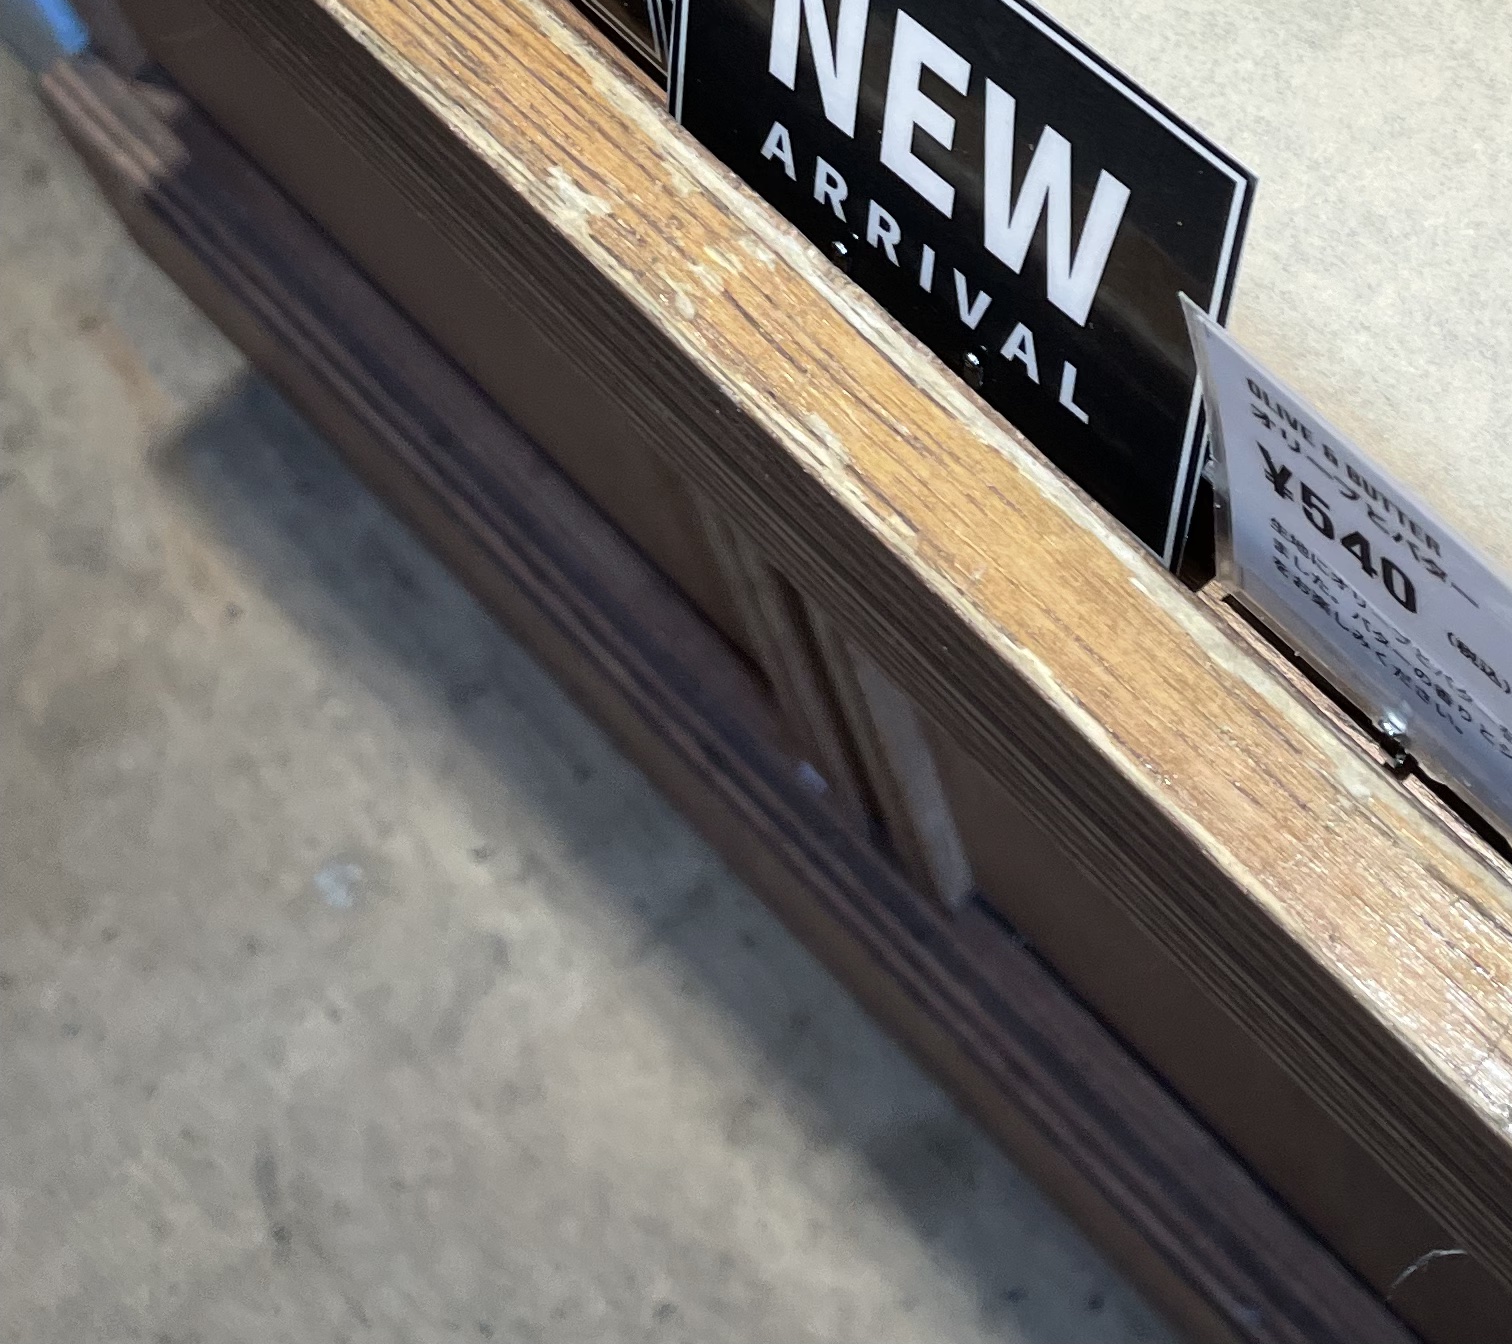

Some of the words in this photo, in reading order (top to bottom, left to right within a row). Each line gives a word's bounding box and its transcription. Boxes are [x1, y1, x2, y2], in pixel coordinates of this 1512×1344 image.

[760, 120, 1090, 425] ARRIVAL
[1246, 376, 1317, 448] OLIVE
[1346, 463, 1442, 559] BUTTER
[1250, 402, 1481, 610] オリーブとバター
[1256, 439, 1418, 614] ¥540
[1272, 555, 1465, 735] をお楽しみください。
